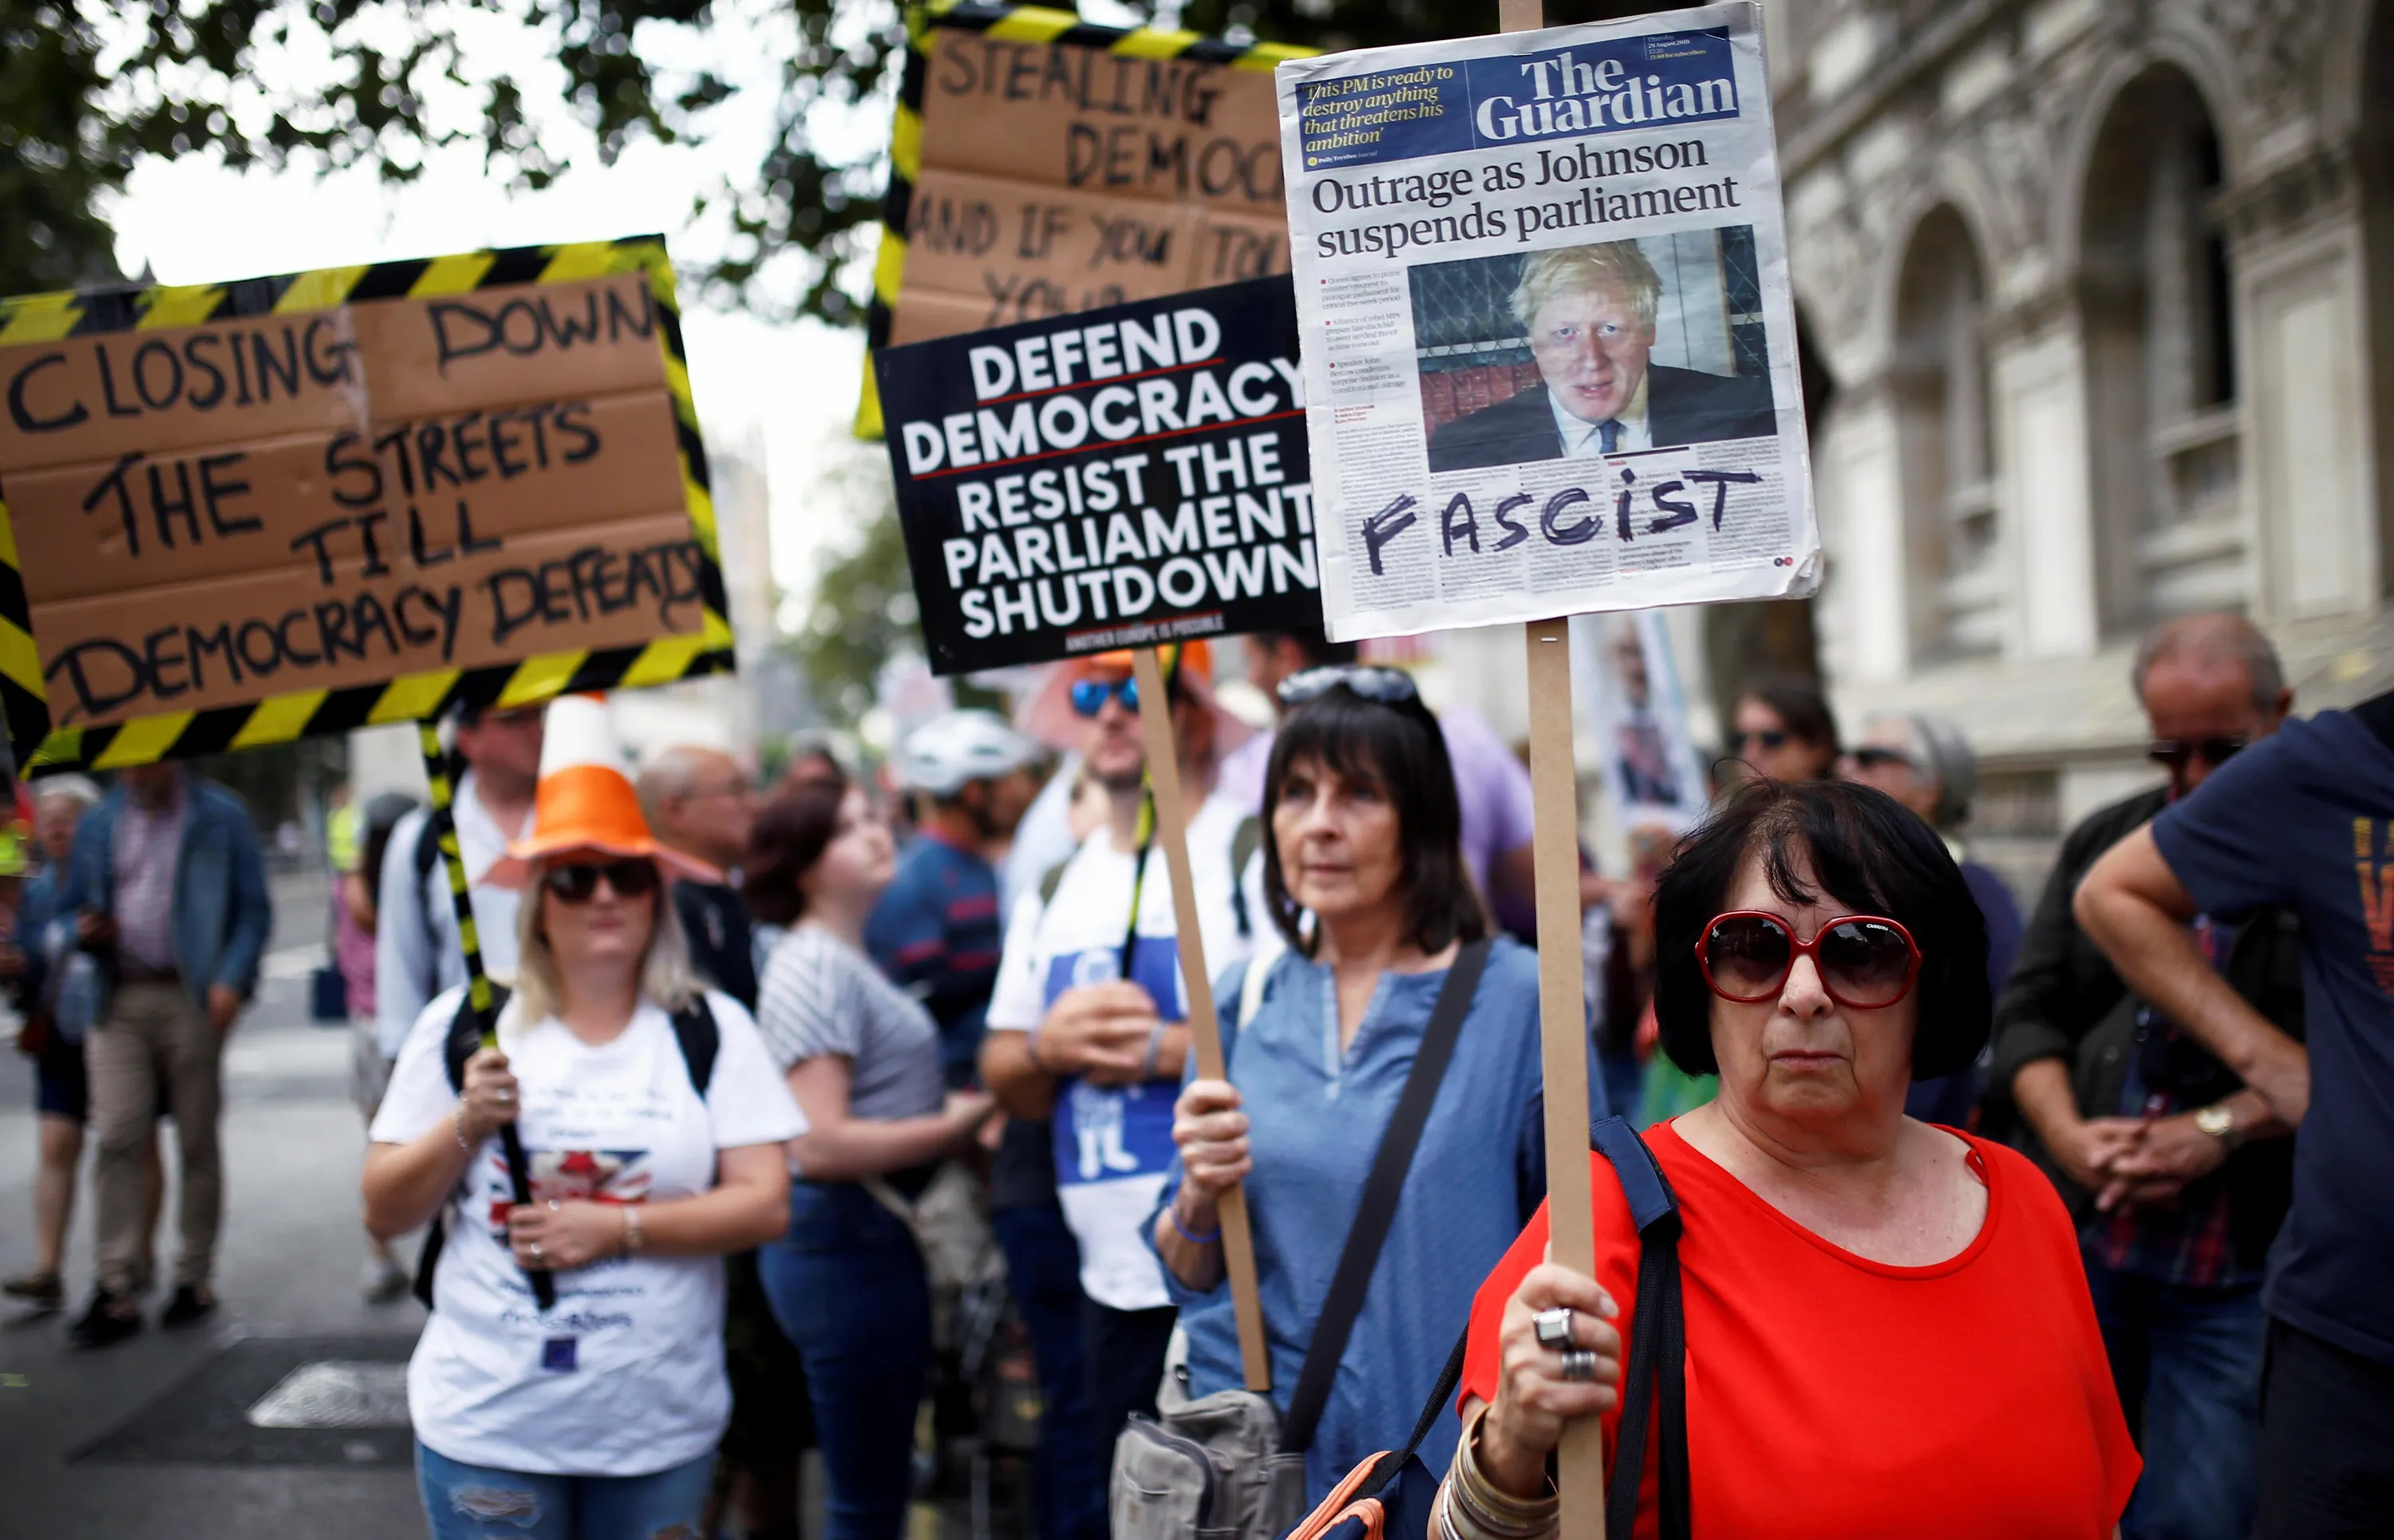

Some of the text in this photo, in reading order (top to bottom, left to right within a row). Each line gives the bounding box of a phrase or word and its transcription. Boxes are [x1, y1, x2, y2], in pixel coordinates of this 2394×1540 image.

[940, 32, 1226, 124] STEALING
[1302, 86, 1439, 117] destroy anything
[1304, 101, 1444, 135] that threatens his
[1342, 77, 1369, 95] PM
[1372, 75, 1385, 89] is
[1387, 67, 1435, 86] ready
[1436, 66, 1453, 80] to
[1476, 74, 1736, 140] Guardian
[1521, 52, 1624, 101] The
[1312, 139, 1709, 213] Outrage as Johnson
[1317, 176, 1742, 259] suspends parliament
[908, 193, 1000, 257] AND
[1015, 202, 1071, 262] IF
[7, 282, 658, 433] CLOSING DOWN
[968, 307, 1221, 401] DEFEND
[901, 357, 1306, 476] DEMOCRACY
[81, 402, 602, 559] THE STREETS
[956, 432, 1285, 534] RESIST THE
[290, 498, 503, 585] TILL
[942, 481, 1315, 589] PARLIAMENT
[959, 537, 1320, 639] SHUTDOWN
[43, 583, 463, 721] DEMOCRACY
